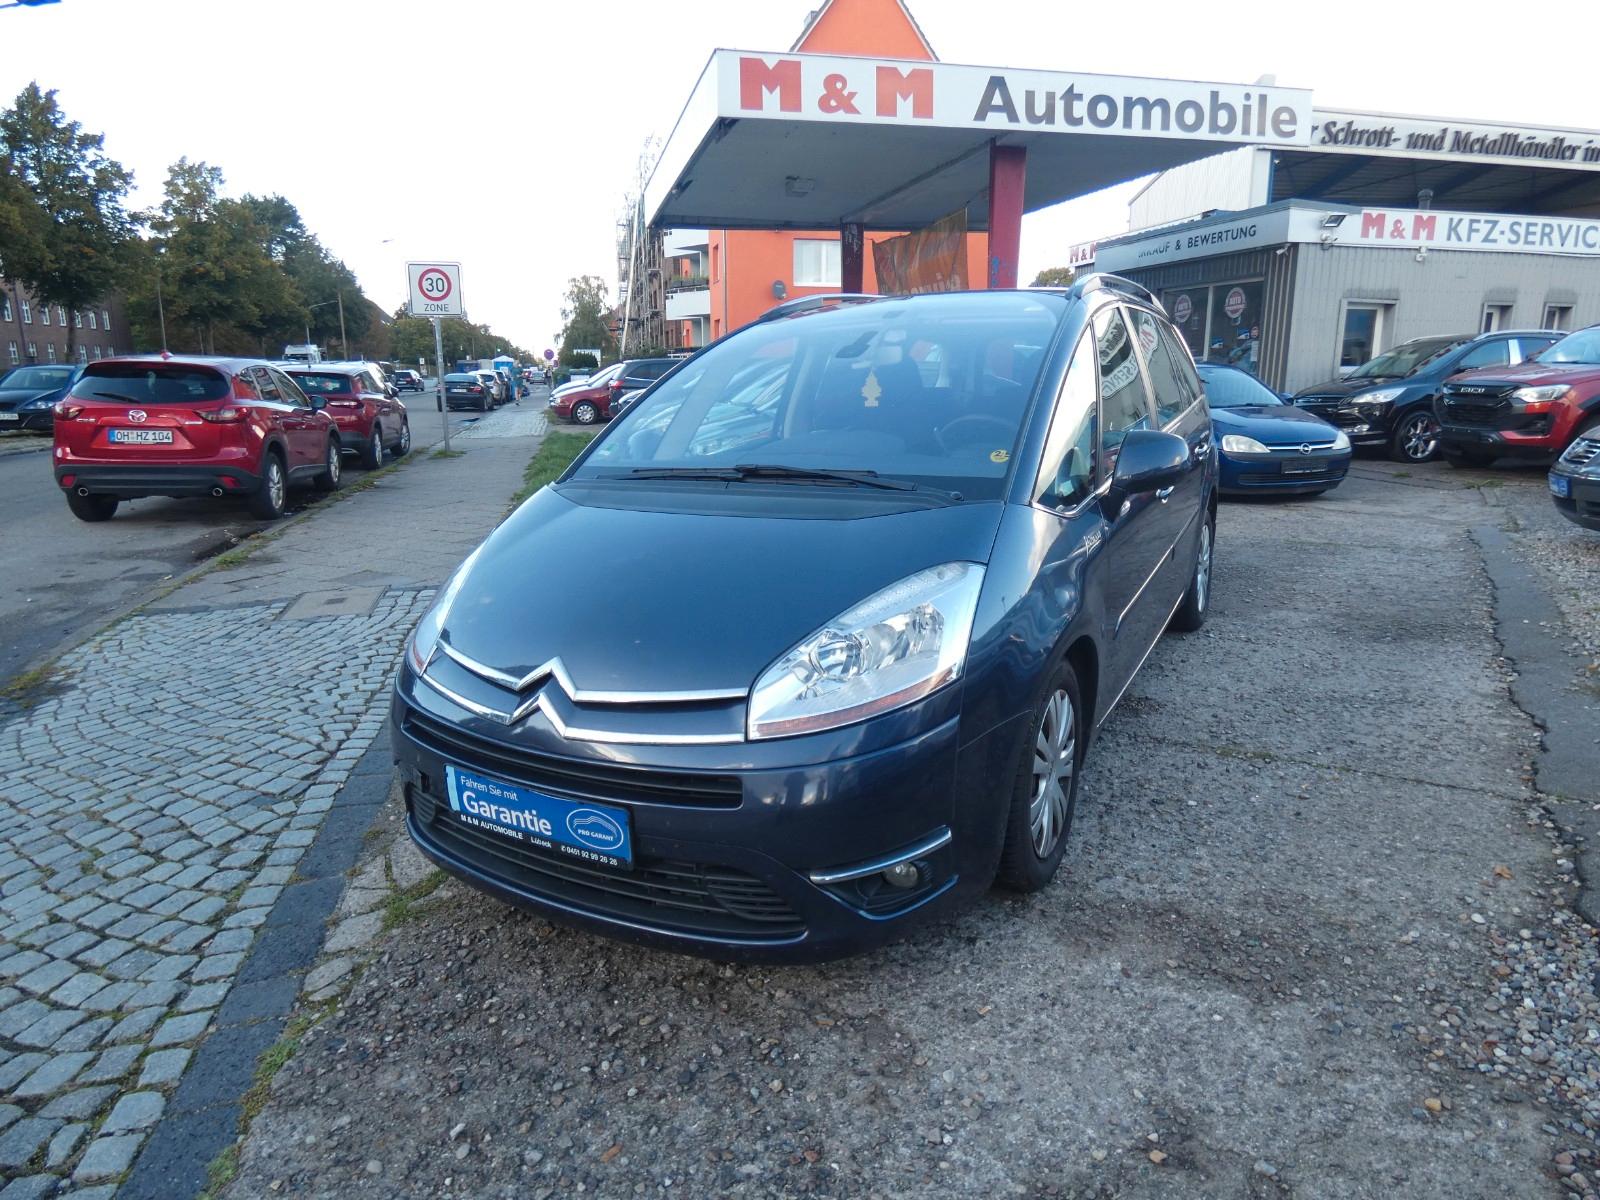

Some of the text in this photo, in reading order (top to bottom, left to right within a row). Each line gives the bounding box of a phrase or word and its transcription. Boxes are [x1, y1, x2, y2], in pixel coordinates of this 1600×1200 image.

[740, 57, 1298, 138] M & M Automobile
[1320, 120, 1401, 147] Schrott-
[1406, 127, 1448, 151] und
[1449, 130, 1582, 160] Metallhändler
[1175, 239, 1181, 251] &
[1187, 224, 1257, 249] BEWERTUNG
[1360, 212, 1600, 249] M & M KFZ-SERVIC
[425, 277, 445, 292] 30
[424, 303, 449, 312] ZONE
[136, 431, 148, 440] HZ
[152, 431, 171, 440] 104
[460, 775, 519, 801] Fahren Sie mit
[462, 790, 552, 836] Garantie
[480, 821, 524, 840] AUTOMOBILE
[577, 828, 590, 836] PRO
